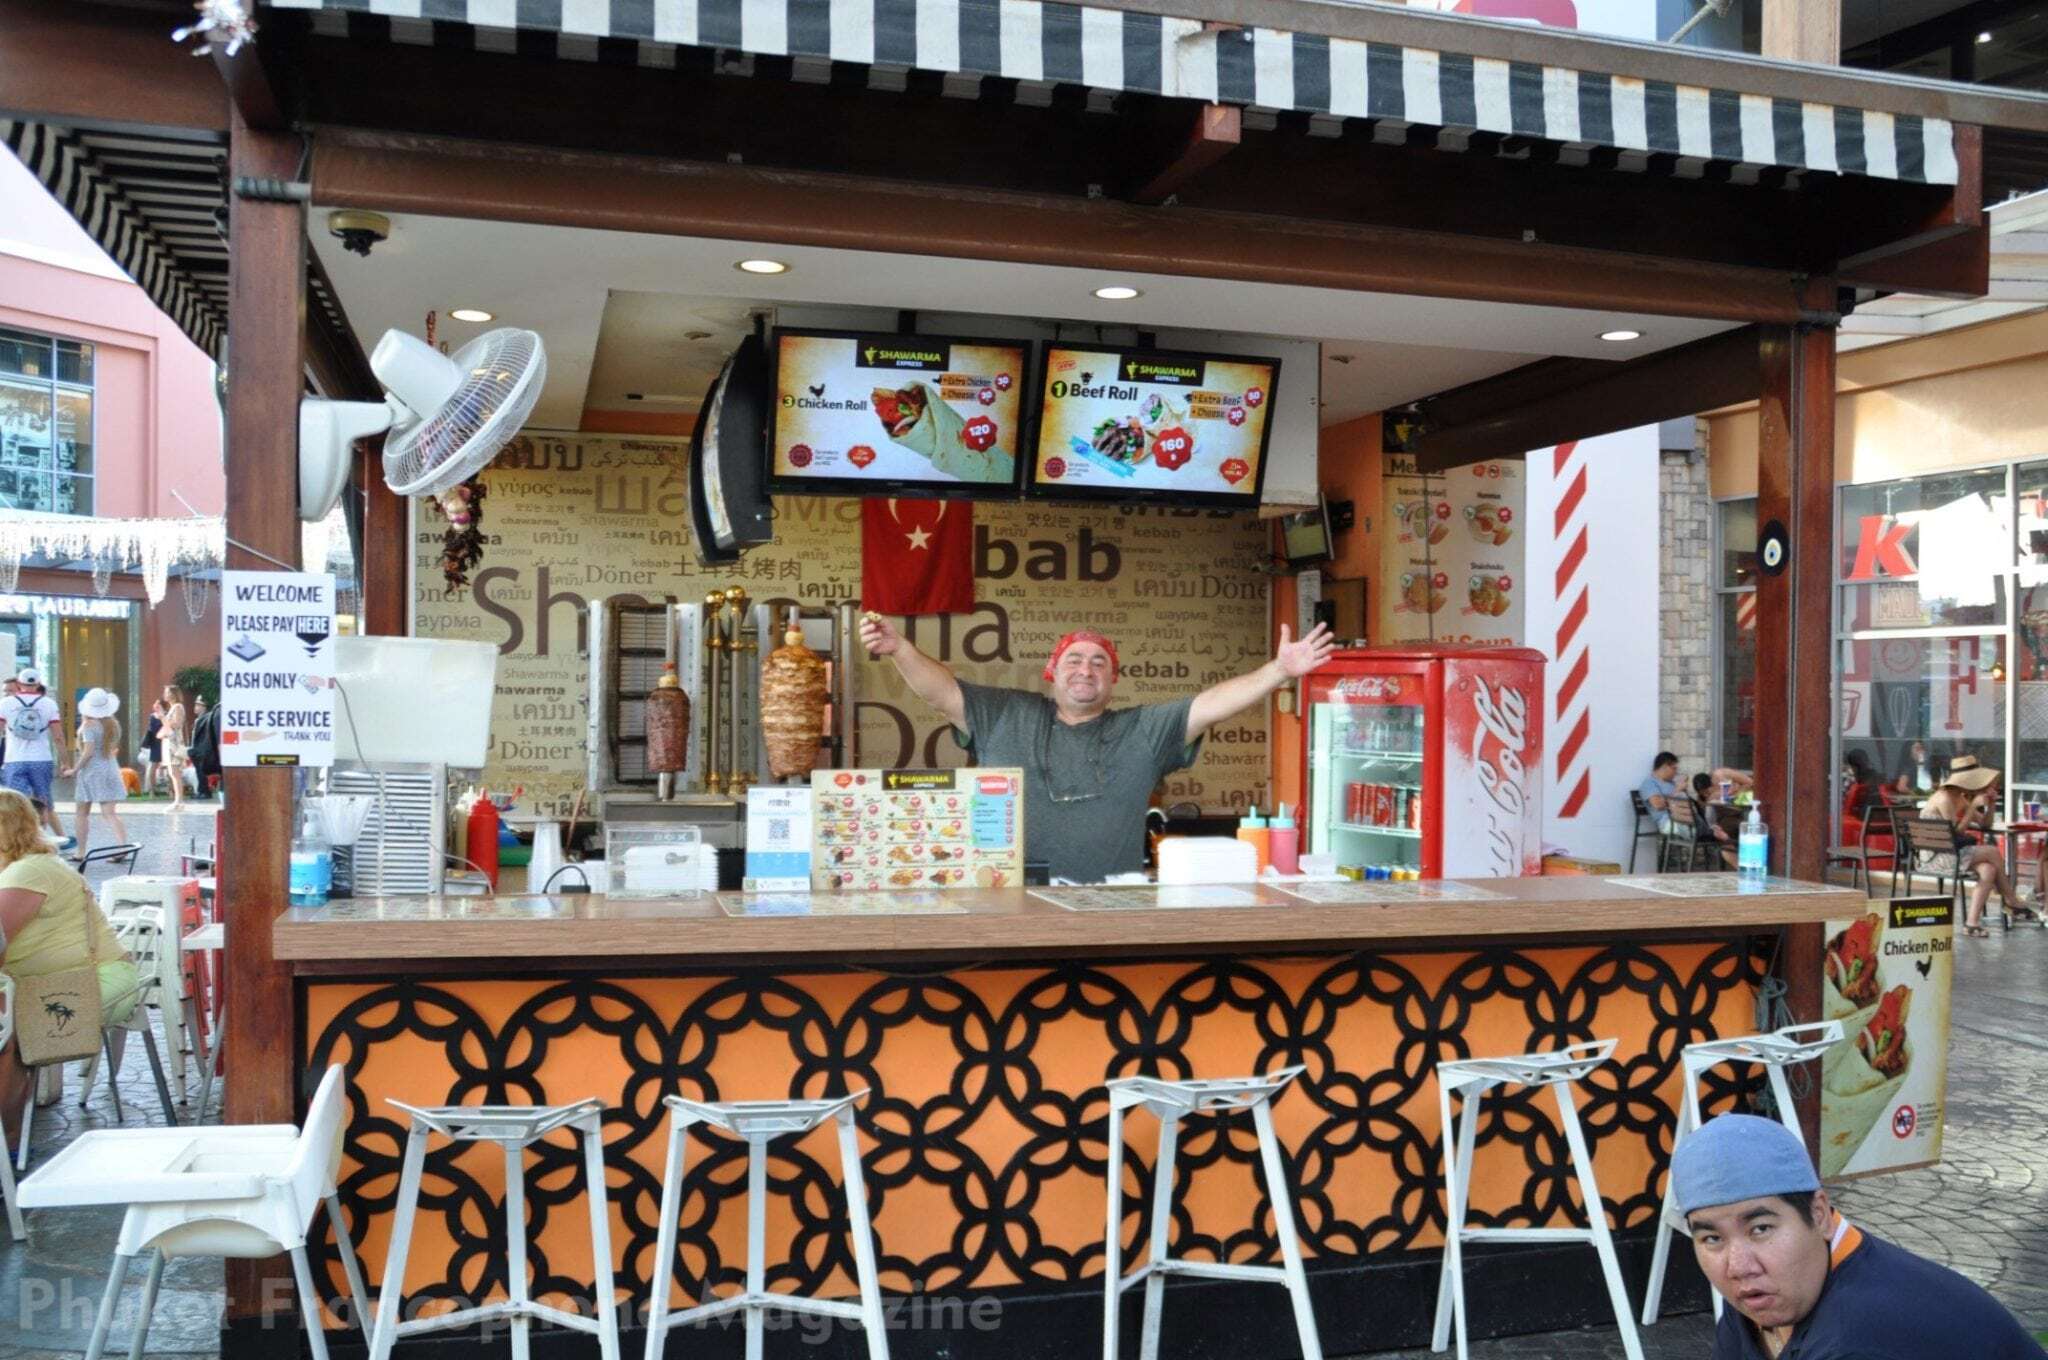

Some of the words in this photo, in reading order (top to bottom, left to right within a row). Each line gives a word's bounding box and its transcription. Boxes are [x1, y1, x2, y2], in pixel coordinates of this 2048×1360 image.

[879, 349, 941, 362] SHAWARMA
[1139, 365, 1197, 377] SHAWARMA
[1053, 383, 1064, 396] 1
[1070, 384, 1105, 398] Beef
[1108, 386, 1138, 401] Roll
[785, 397, 793, 406] 3
[797, 398, 842, 411] Chicken
[845, 399, 867, 411] Roll
[969, 424, 991, 437] 120
[1160, 437, 1185, 453] 160
[500, 479, 554, 497] γύρος
[585, 564, 656, 586] Döner
[235, 584, 323, 603] WELCOME
[798, 576, 853, 599] เคบับ
[1134, 572, 1195, 598] เคบับ
[1009, 606, 1128, 623] chawarma
[227, 615, 270, 632] PLEASE
[272, 616, 294, 632] PAY
[297, 616, 329, 634] HERE
[225, 672, 260, 689] CASH
[263, 672, 297, 689] ONLY
[513, 696, 576, 721] เคบับ
[227, 710, 264, 727] SELF
[267, 711, 331, 727] SERVICE
[284, 731, 311, 741] THANK
[314, 731, 331, 741] YOU
[501, 740, 574, 760] Döner
[900, 774, 950, 785] SHAWARMA
[1904, 906, 1948, 918] SHAWARMA
[1884, 940, 1929, 956] Chicken
[1931, 937, 1953, 952] Roll
